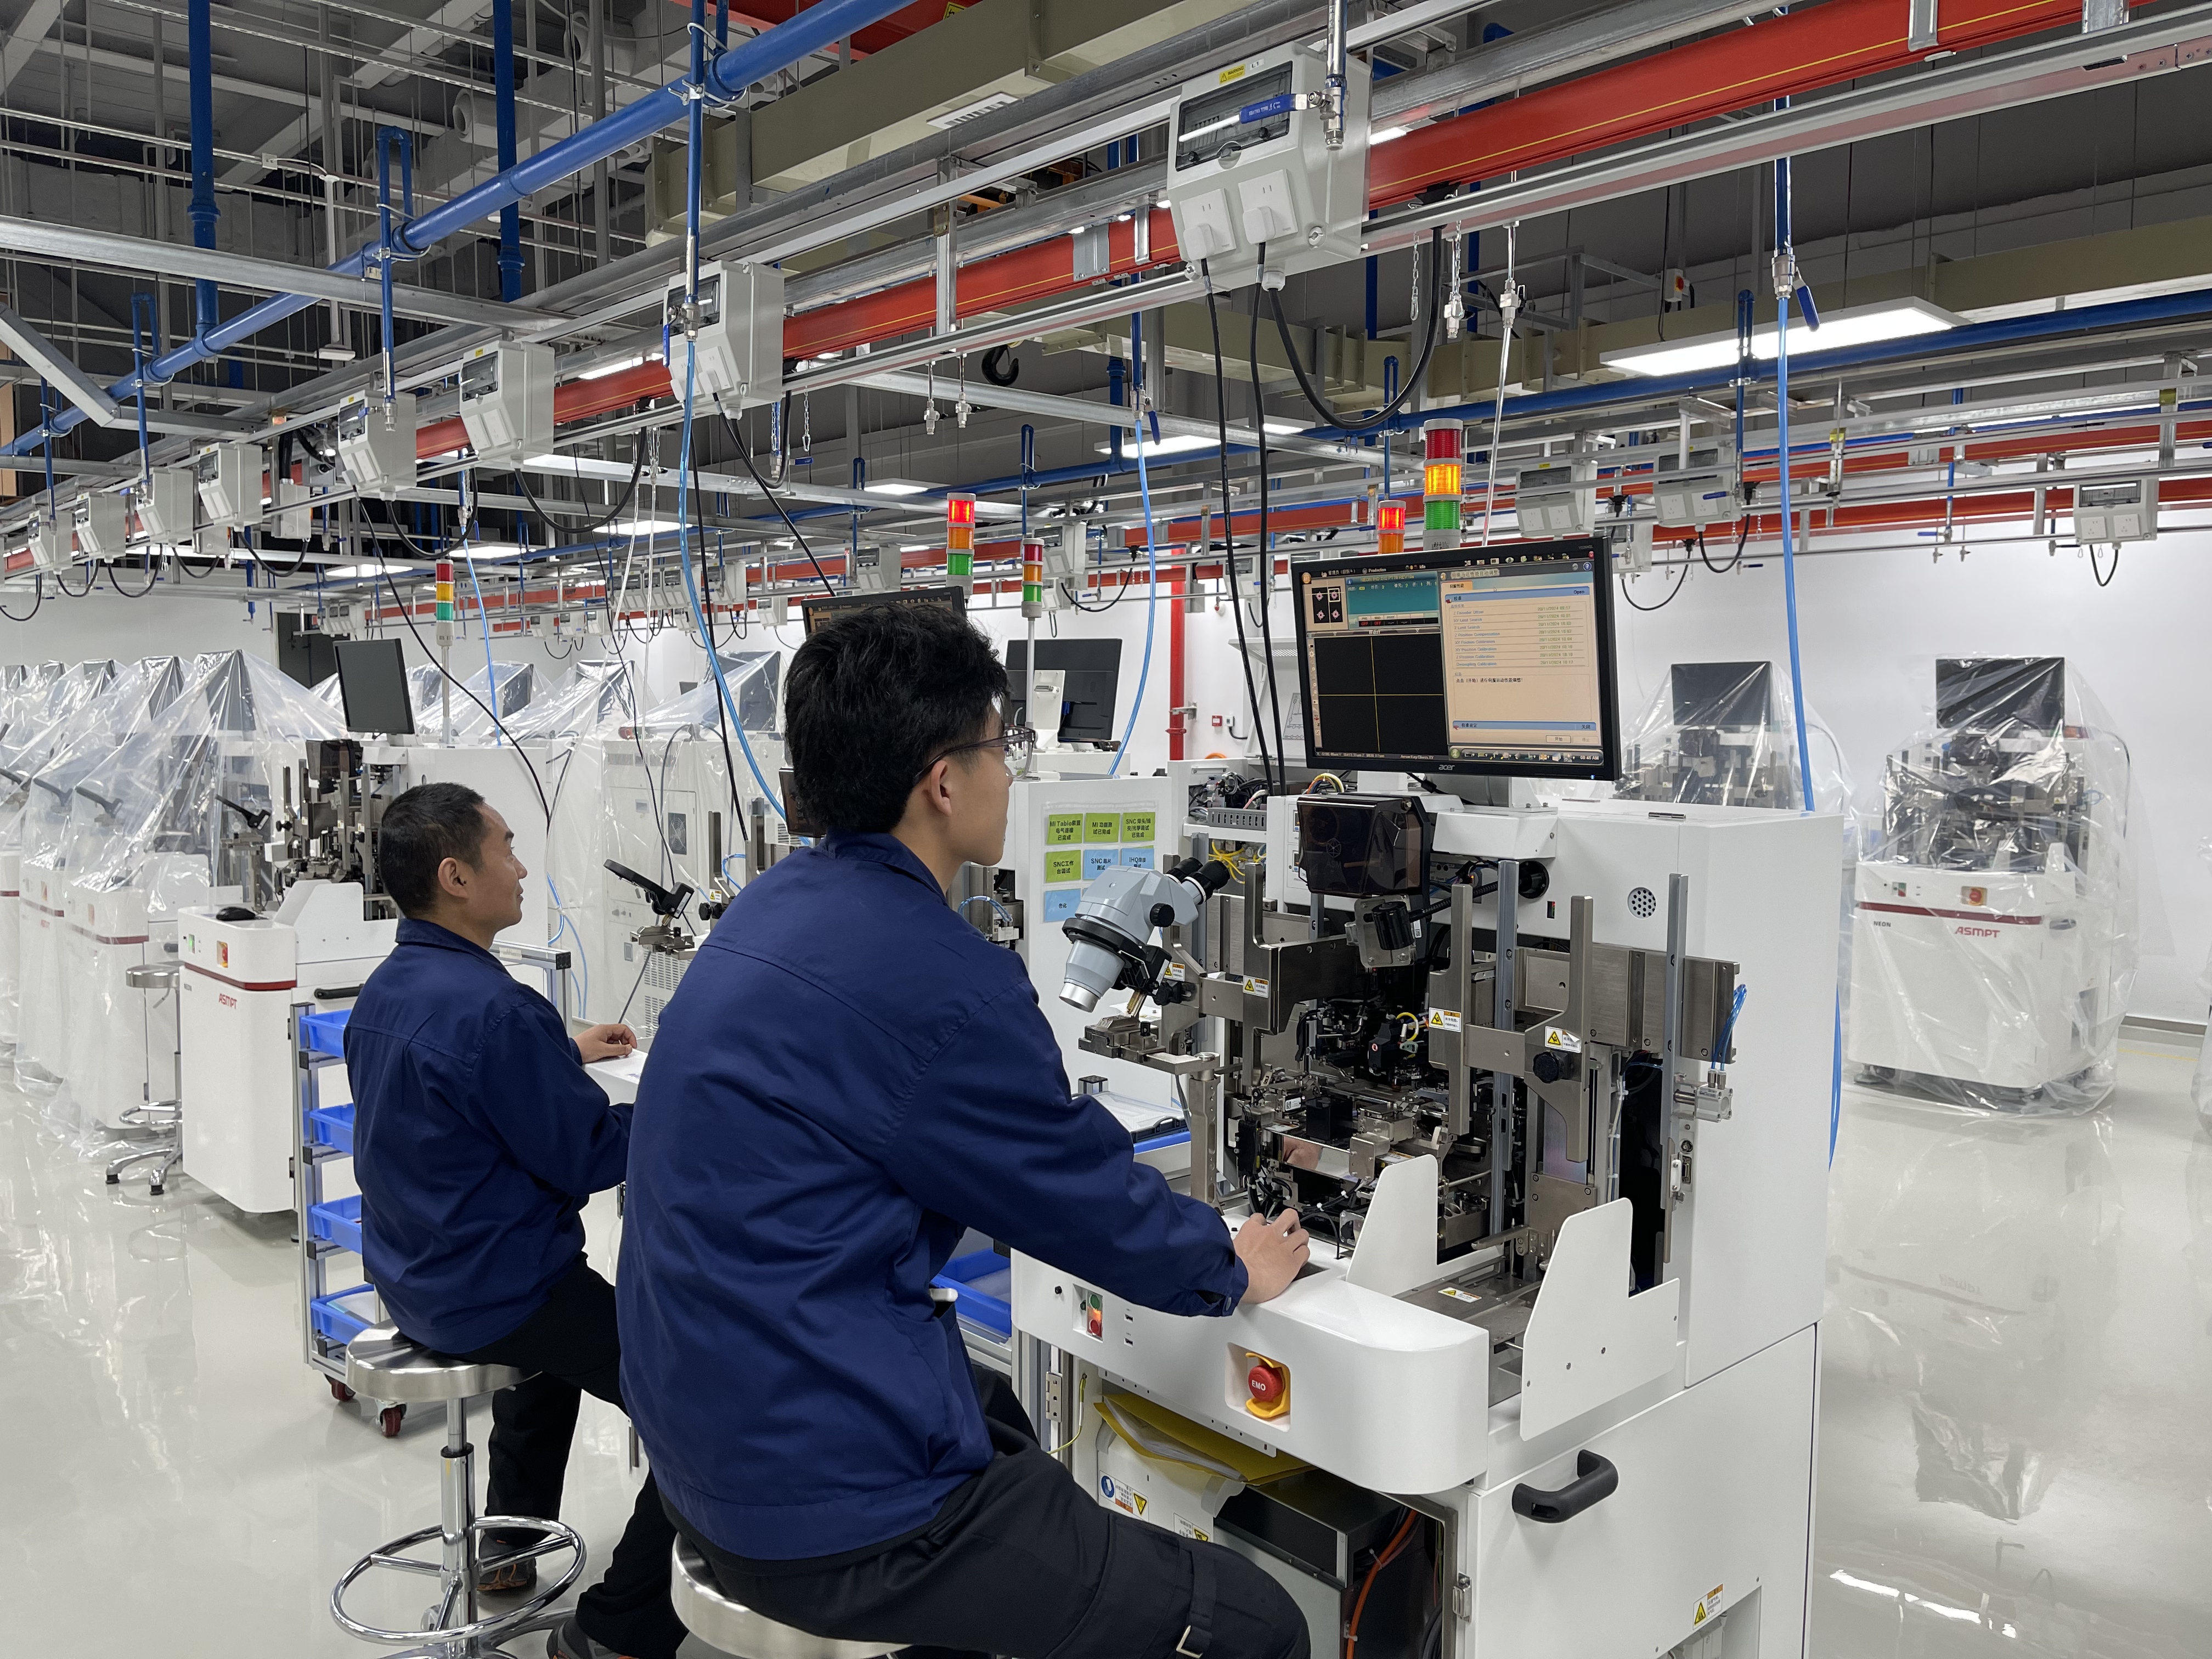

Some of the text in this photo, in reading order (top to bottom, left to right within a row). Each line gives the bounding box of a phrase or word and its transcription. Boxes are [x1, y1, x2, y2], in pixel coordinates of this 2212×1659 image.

[1955, 926, 2000, 938] ASMPT
[218, 993, 238, 1009] ASMPT
[1251, 1379, 1266, 1391] EMO
